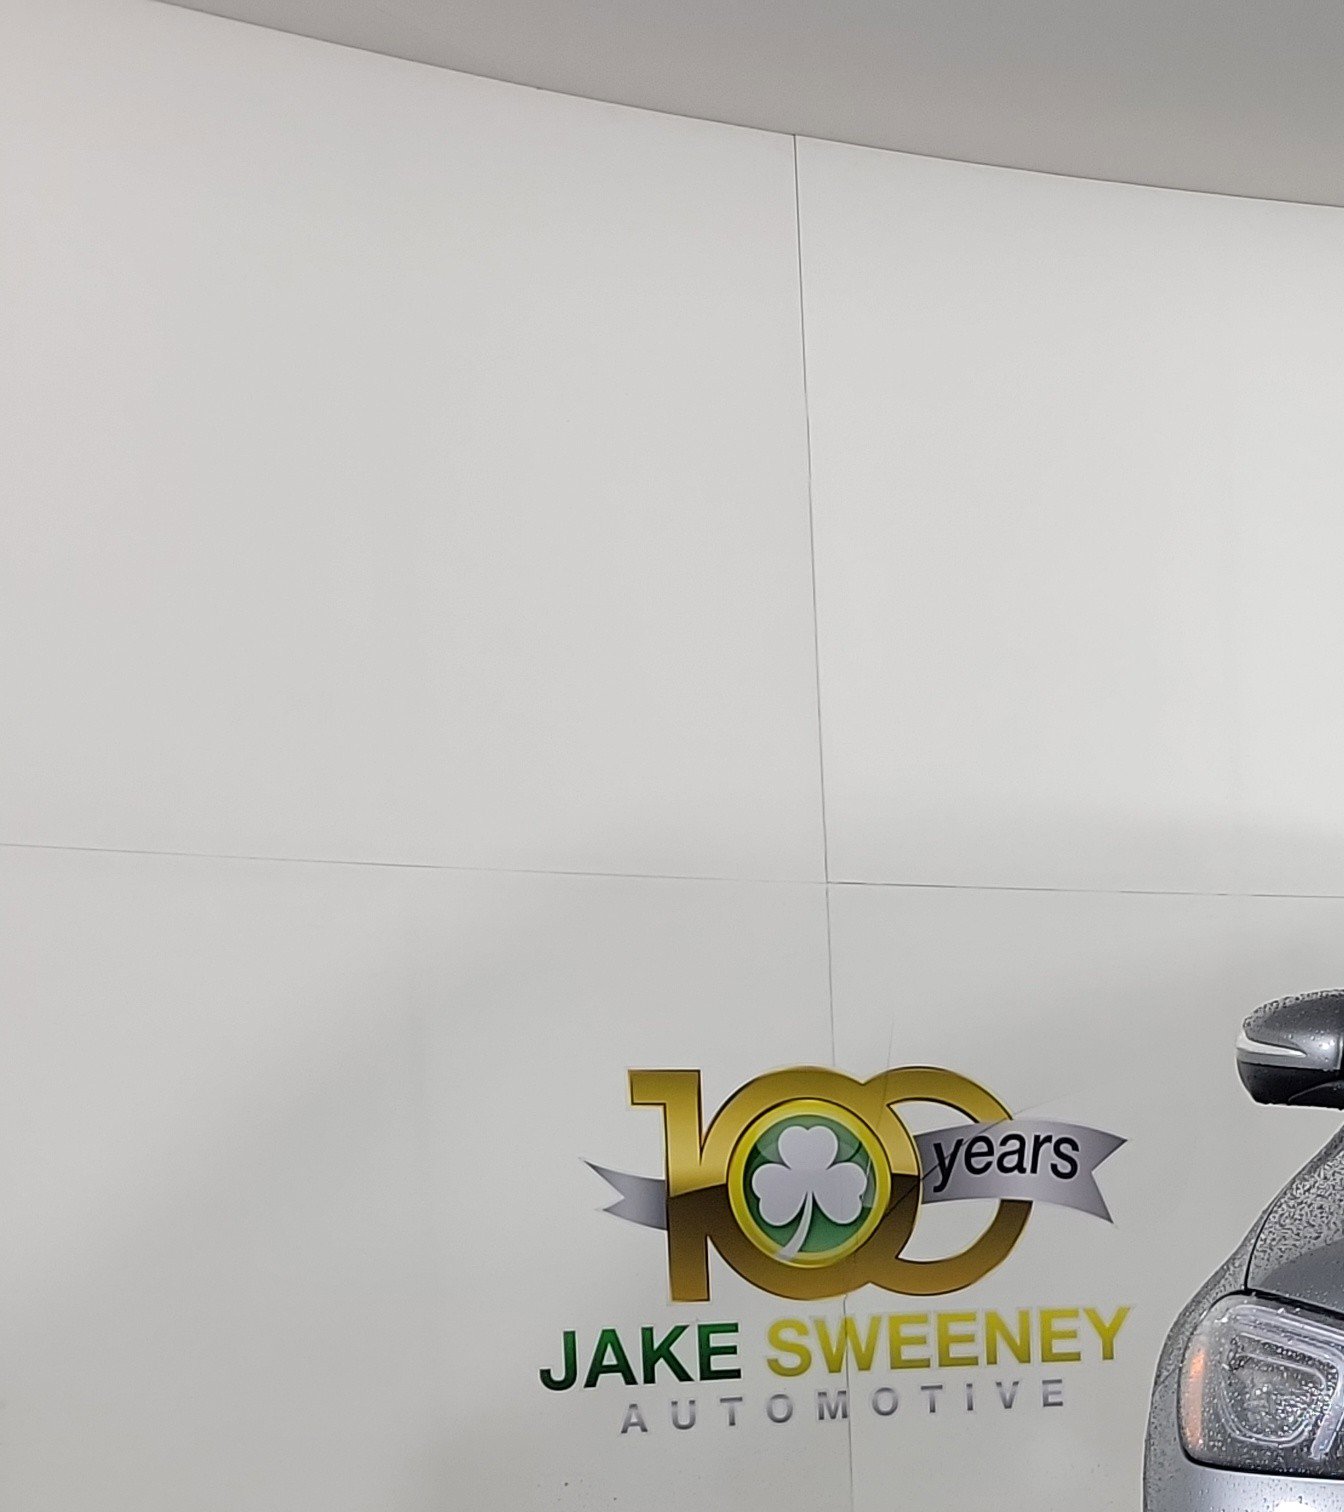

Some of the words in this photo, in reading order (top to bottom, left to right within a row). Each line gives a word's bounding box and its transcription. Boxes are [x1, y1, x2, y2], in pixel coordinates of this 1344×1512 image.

[628, 1066, 1033, 1301] 100
[933, 1133, 1079, 1192] years
[539, 1322, 741, 1390] JAKE
[766, 1306, 1131, 1377] SWEENEY
[620, 1379, 1064, 1434] AUTOMOTIVE
